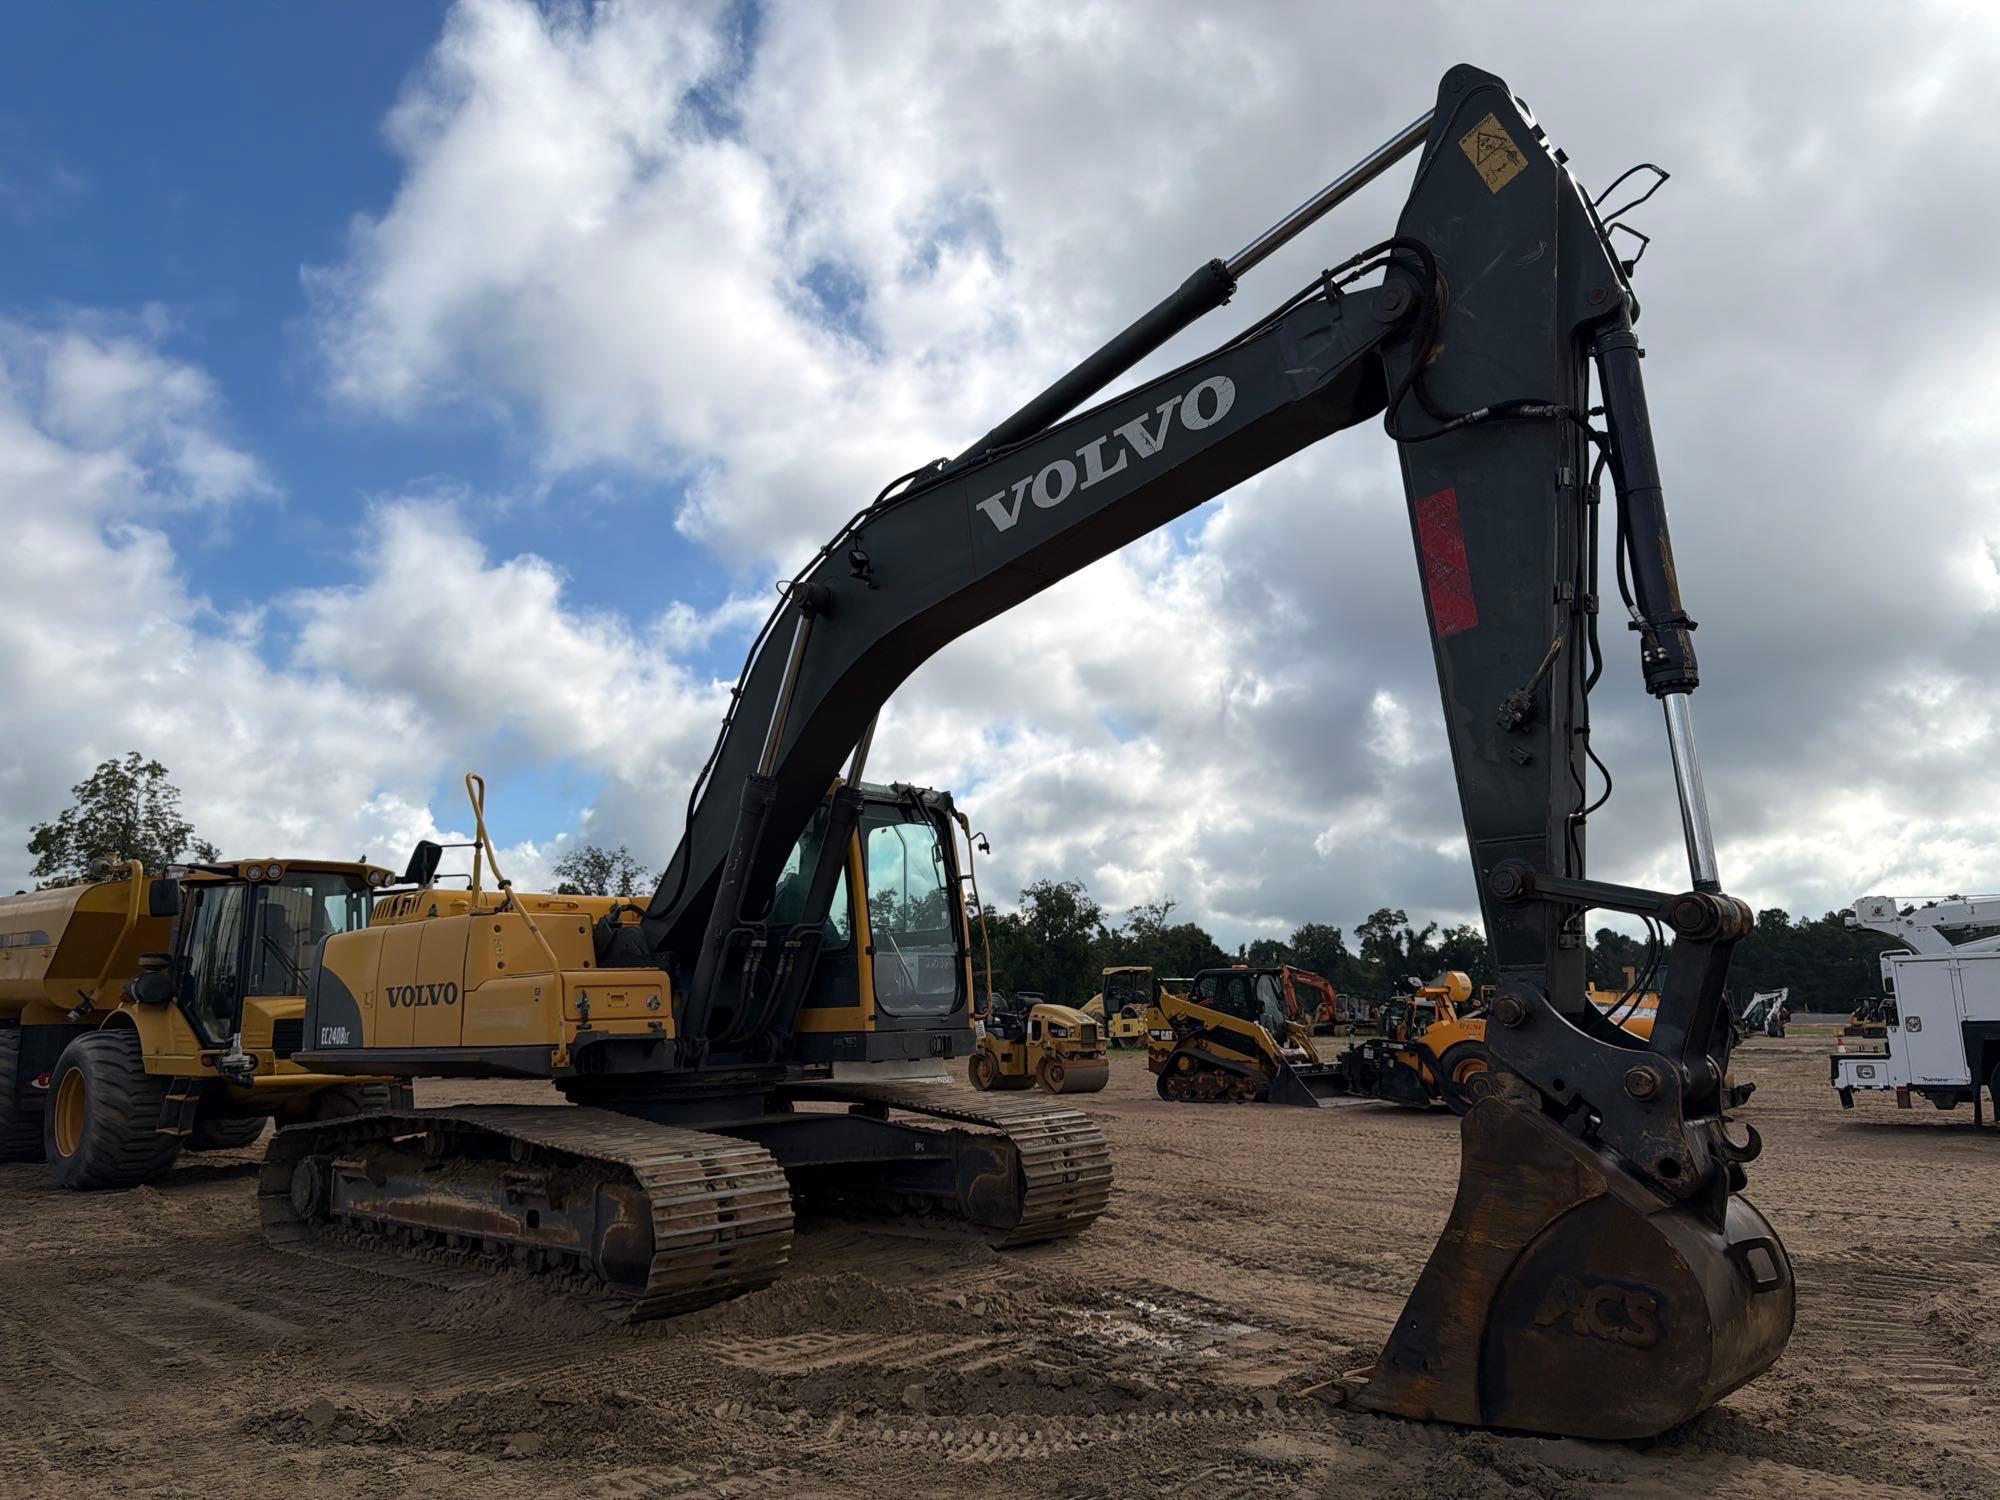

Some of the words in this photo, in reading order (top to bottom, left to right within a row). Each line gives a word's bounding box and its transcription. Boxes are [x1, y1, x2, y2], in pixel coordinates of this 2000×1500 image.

[976, 376, 1236, 532] VOLVO
[386, 982, 458, 1008] VOLVO
[1160, 1030, 1173, 1041] CAT
